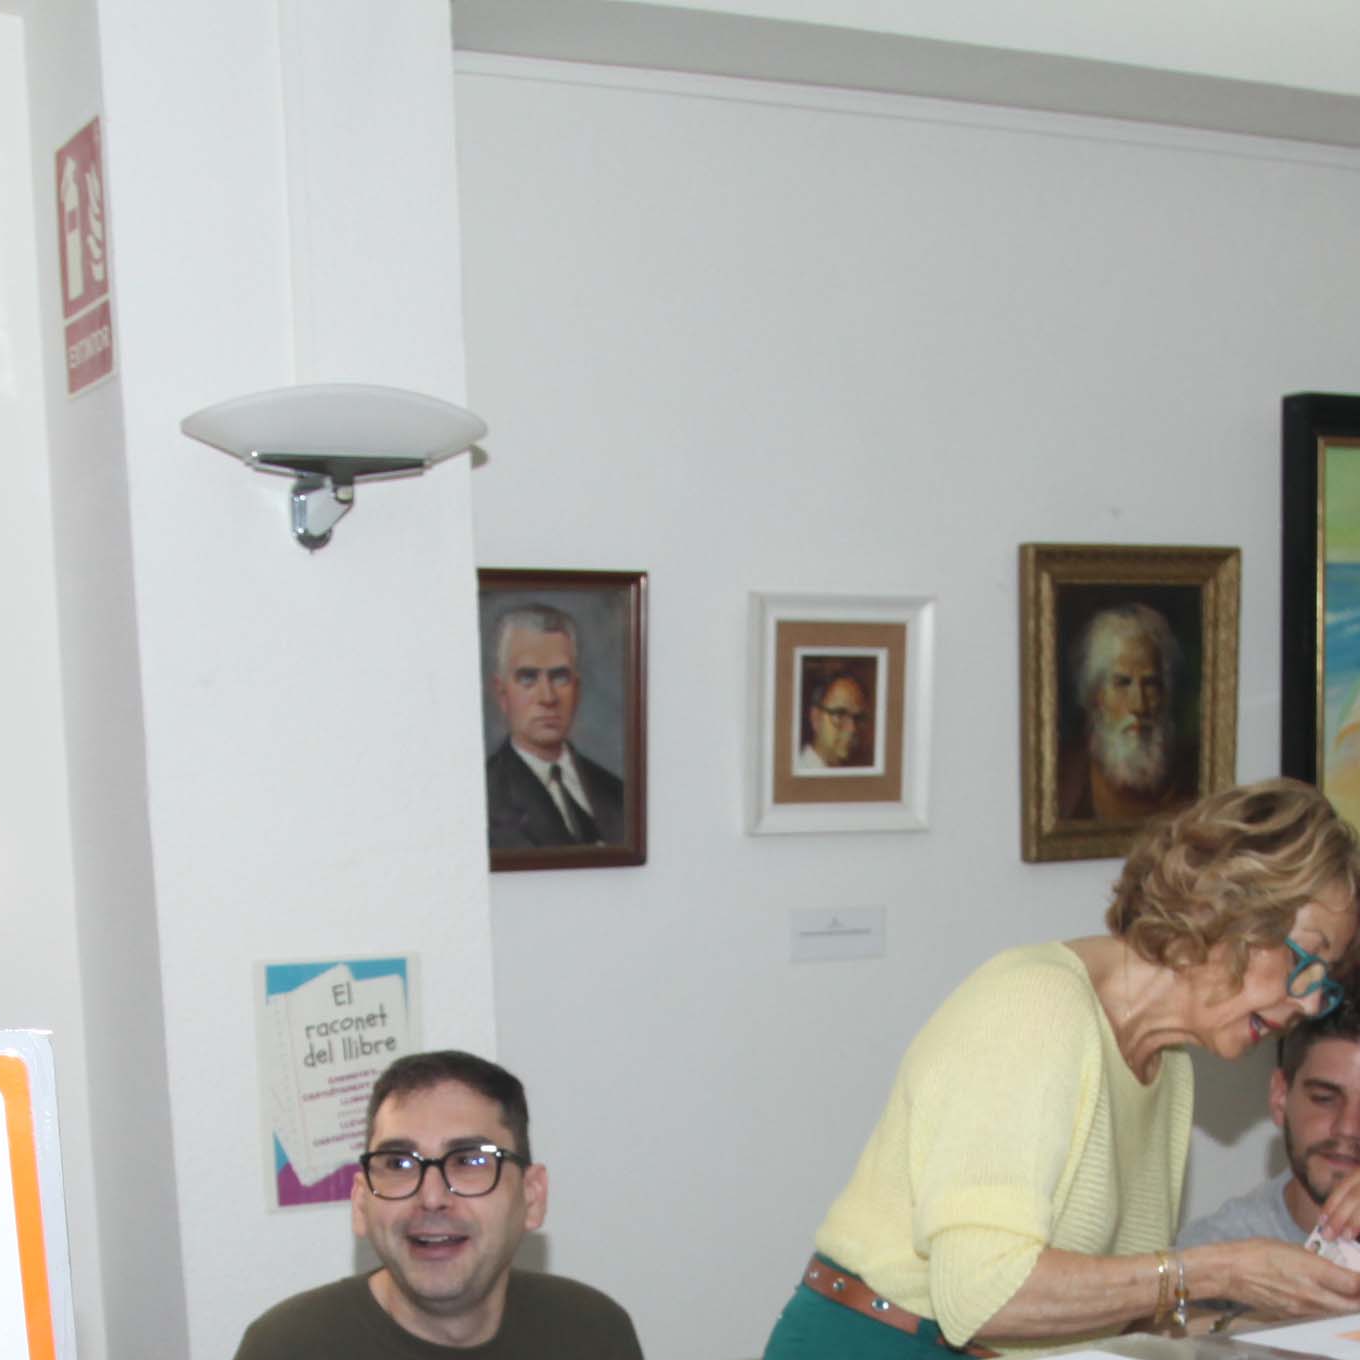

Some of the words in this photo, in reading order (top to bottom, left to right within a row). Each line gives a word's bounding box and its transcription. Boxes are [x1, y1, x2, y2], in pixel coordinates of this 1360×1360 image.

[331, 981, 353, 1006] El
[305, 1004, 387, 1038] raconet
[304, 1040, 334, 1067] del
[342, 1034, 397, 1062] llibre
